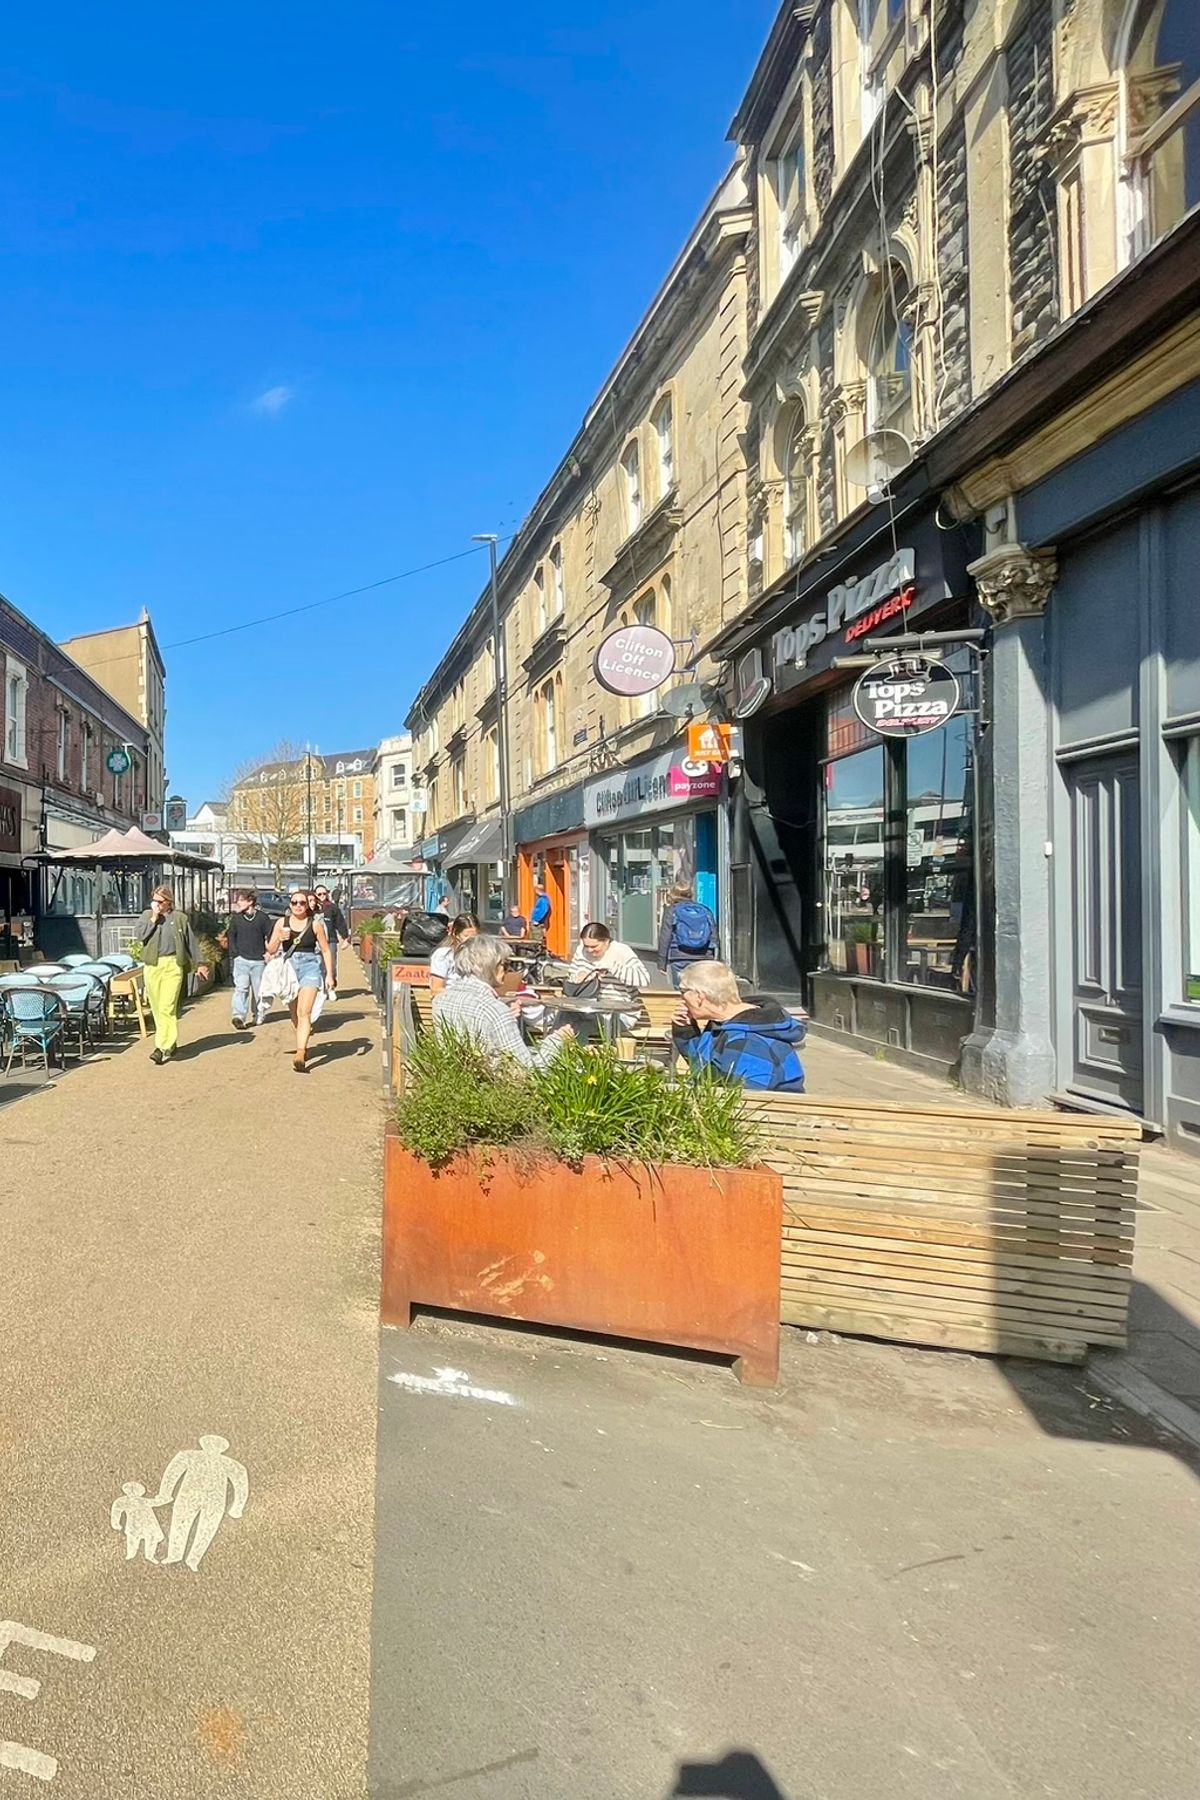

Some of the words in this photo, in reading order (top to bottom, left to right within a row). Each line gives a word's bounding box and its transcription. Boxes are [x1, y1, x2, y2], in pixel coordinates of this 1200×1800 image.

[772, 612, 827, 666] Tops
[827, 547, 916, 634] Pizza
[615, 638, 664, 658] Clifton
[621, 652, 645, 666] Off
[602, 659, 661, 682] Licence
[864, 680, 926, 703] Tops
[874, 700, 949, 719] Pizza
[674, 780, 716, 792] payzone
